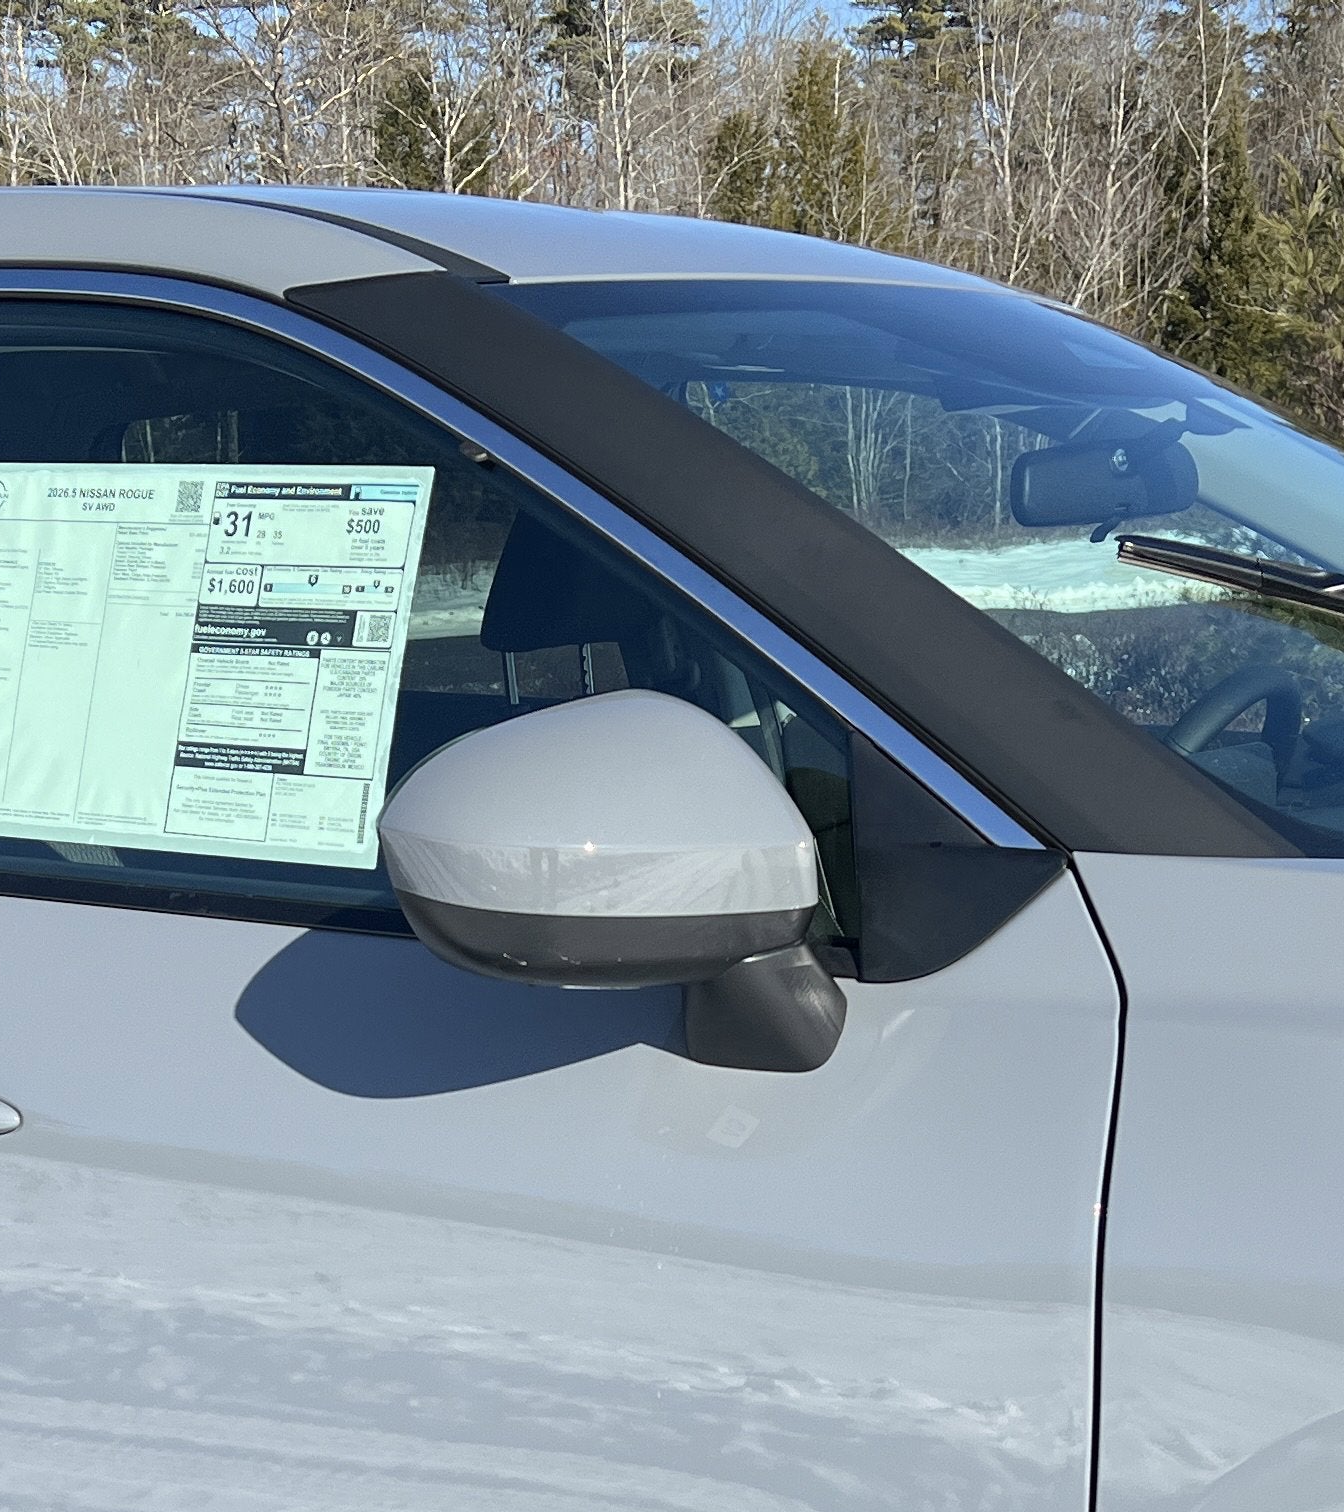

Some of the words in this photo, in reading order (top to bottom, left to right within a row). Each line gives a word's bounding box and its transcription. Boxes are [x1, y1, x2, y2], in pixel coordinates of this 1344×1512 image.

[47, 487, 77, 499] 2026.5
[78, 488, 116, 499] NISSAN
[119, 488, 155, 500] ROGUE
[230, 485, 247, 494] Fuel
[247, 485, 281, 497] Economy
[281, 486, 296, 495] and
[82, 502, 94, 512] SV
[95, 503, 115, 512] AWD
[361, 507, 385, 516] save
[224, 510, 253, 537] 31
[345, 517, 381, 535] $500
[207, 577, 255, 595] $1,600
[194, 623, 267, 638] fueleconomy.gov
